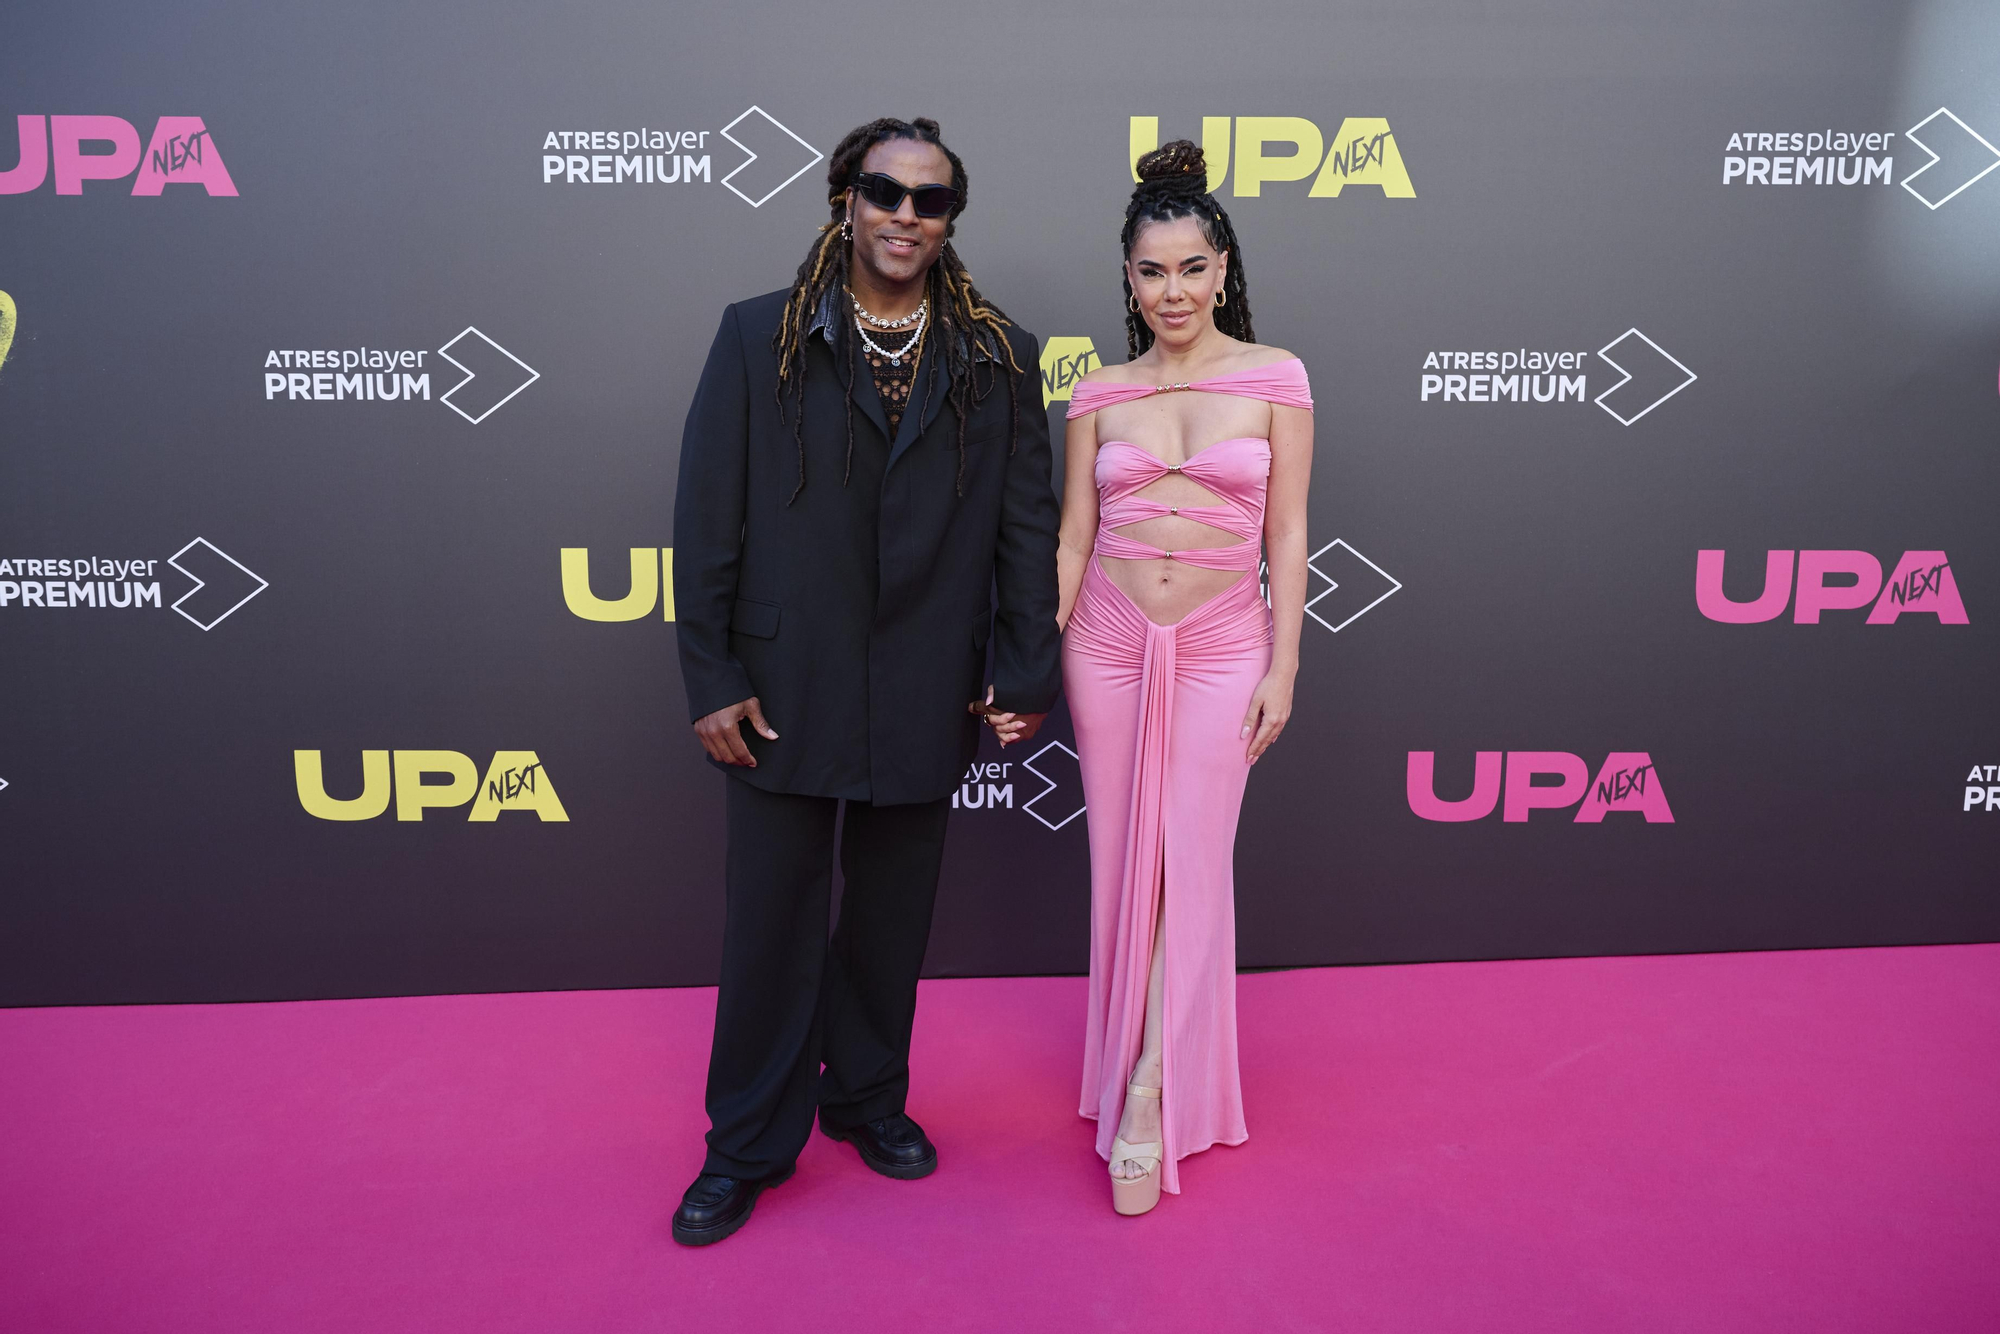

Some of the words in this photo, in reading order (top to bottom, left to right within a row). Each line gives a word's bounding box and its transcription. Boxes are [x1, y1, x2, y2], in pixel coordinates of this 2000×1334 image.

[152, 129, 209, 177] NEXT
[542, 127, 710, 155] ATRESplayer
[1129, 116, 1417, 198] UPA
[1332, 130, 1393, 179] NEXT
[1725, 129, 1896, 157] ATRESplayer
[542, 155, 712, 184] PREMIUM
[1722, 156, 1894, 186] PREMIUM
[264, 346, 428, 373] ATRESplayer
[1040, 349, 1097, 396] NEXT
[1422, 348, 1588, 375] ATRESplayer
[264, 373, 431, 401] PREMIUM
[1420, 374, 1587, 403] PREMIUM
[0, 556, 158, 582] ATRESplayer
[1695, 549, 1971, 625] UPA
[1890, 562, 1949, 607] NEXT
[0, 580, 162, 608] PREMIUM
[293, 749, 571, 822] UPA
[488, 761, 541, 805] NEXT
[1406, 750, 1676, 824] UPA
[1597, 763, 1653, 806] NEXT
